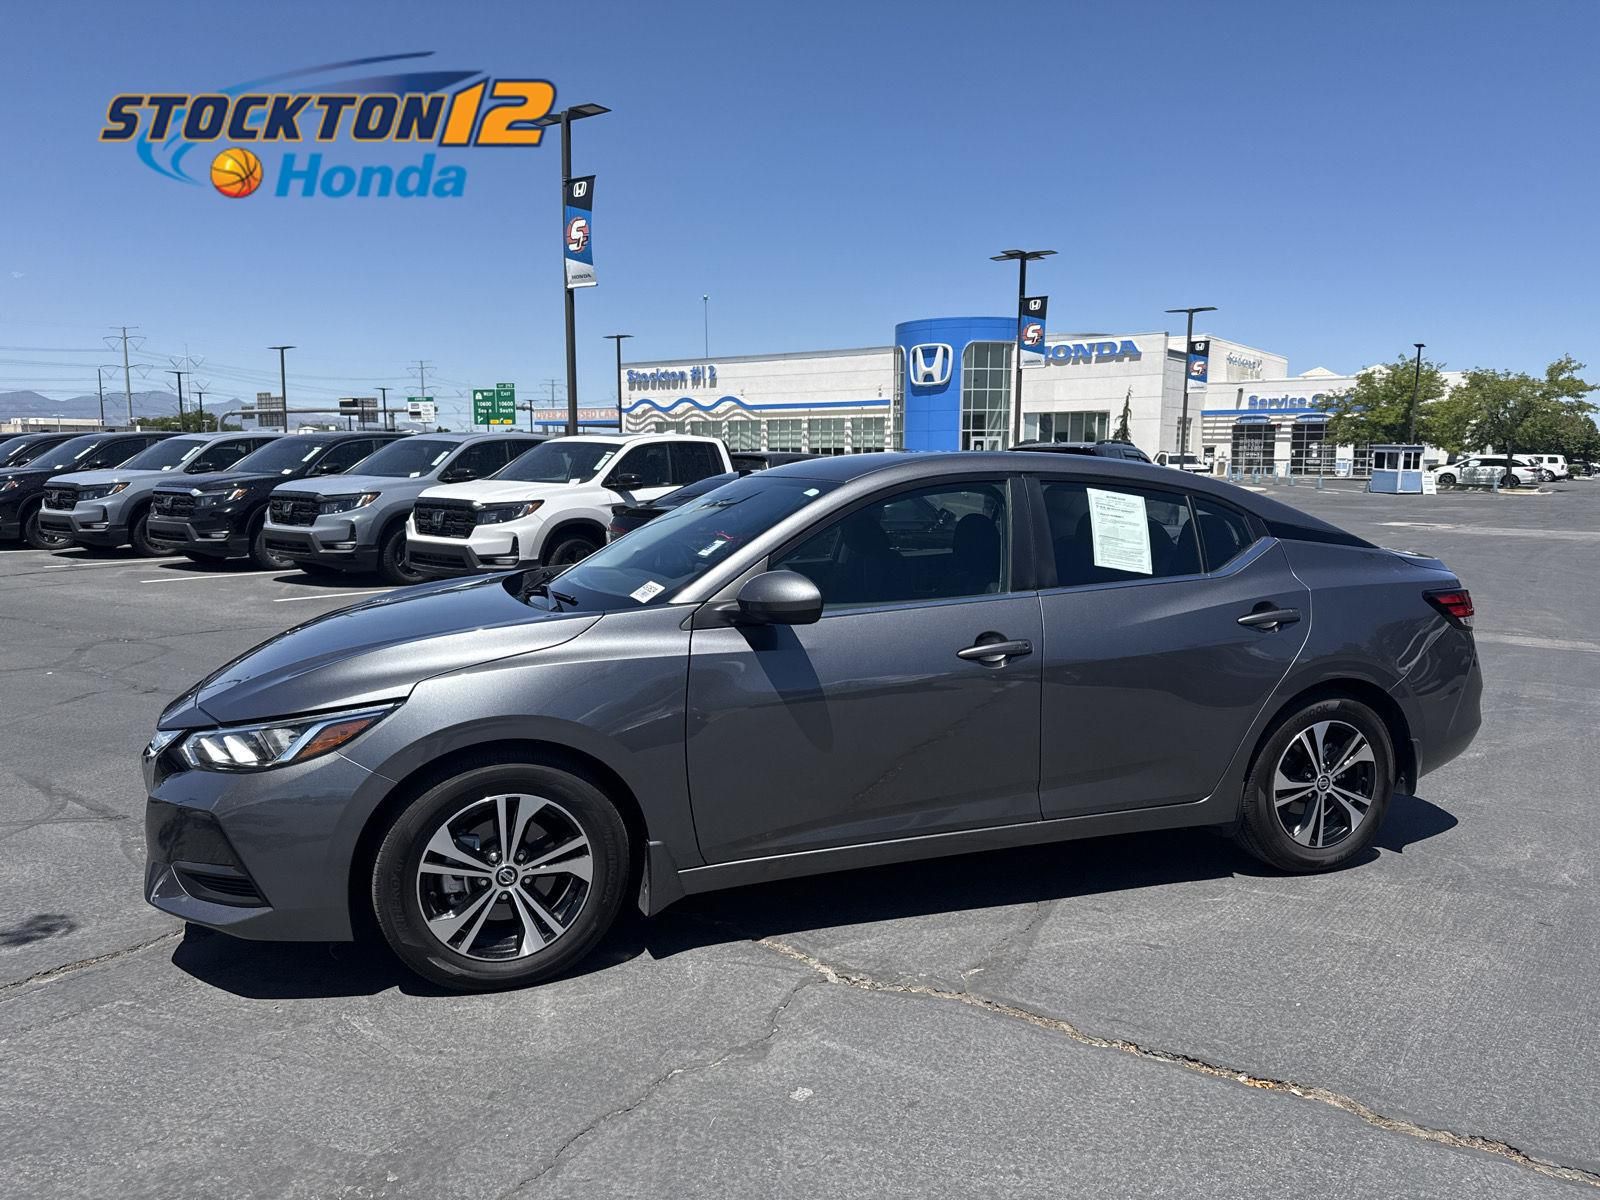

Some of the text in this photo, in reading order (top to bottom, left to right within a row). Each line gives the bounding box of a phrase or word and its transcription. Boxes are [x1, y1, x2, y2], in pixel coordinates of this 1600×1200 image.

[1045, 340, 1141, 361] ONDA
[627, 365, 717, 383] Stockton #12
[1248, 394, 1307, 408] Service
[599, 409, 619, 418] CAR
